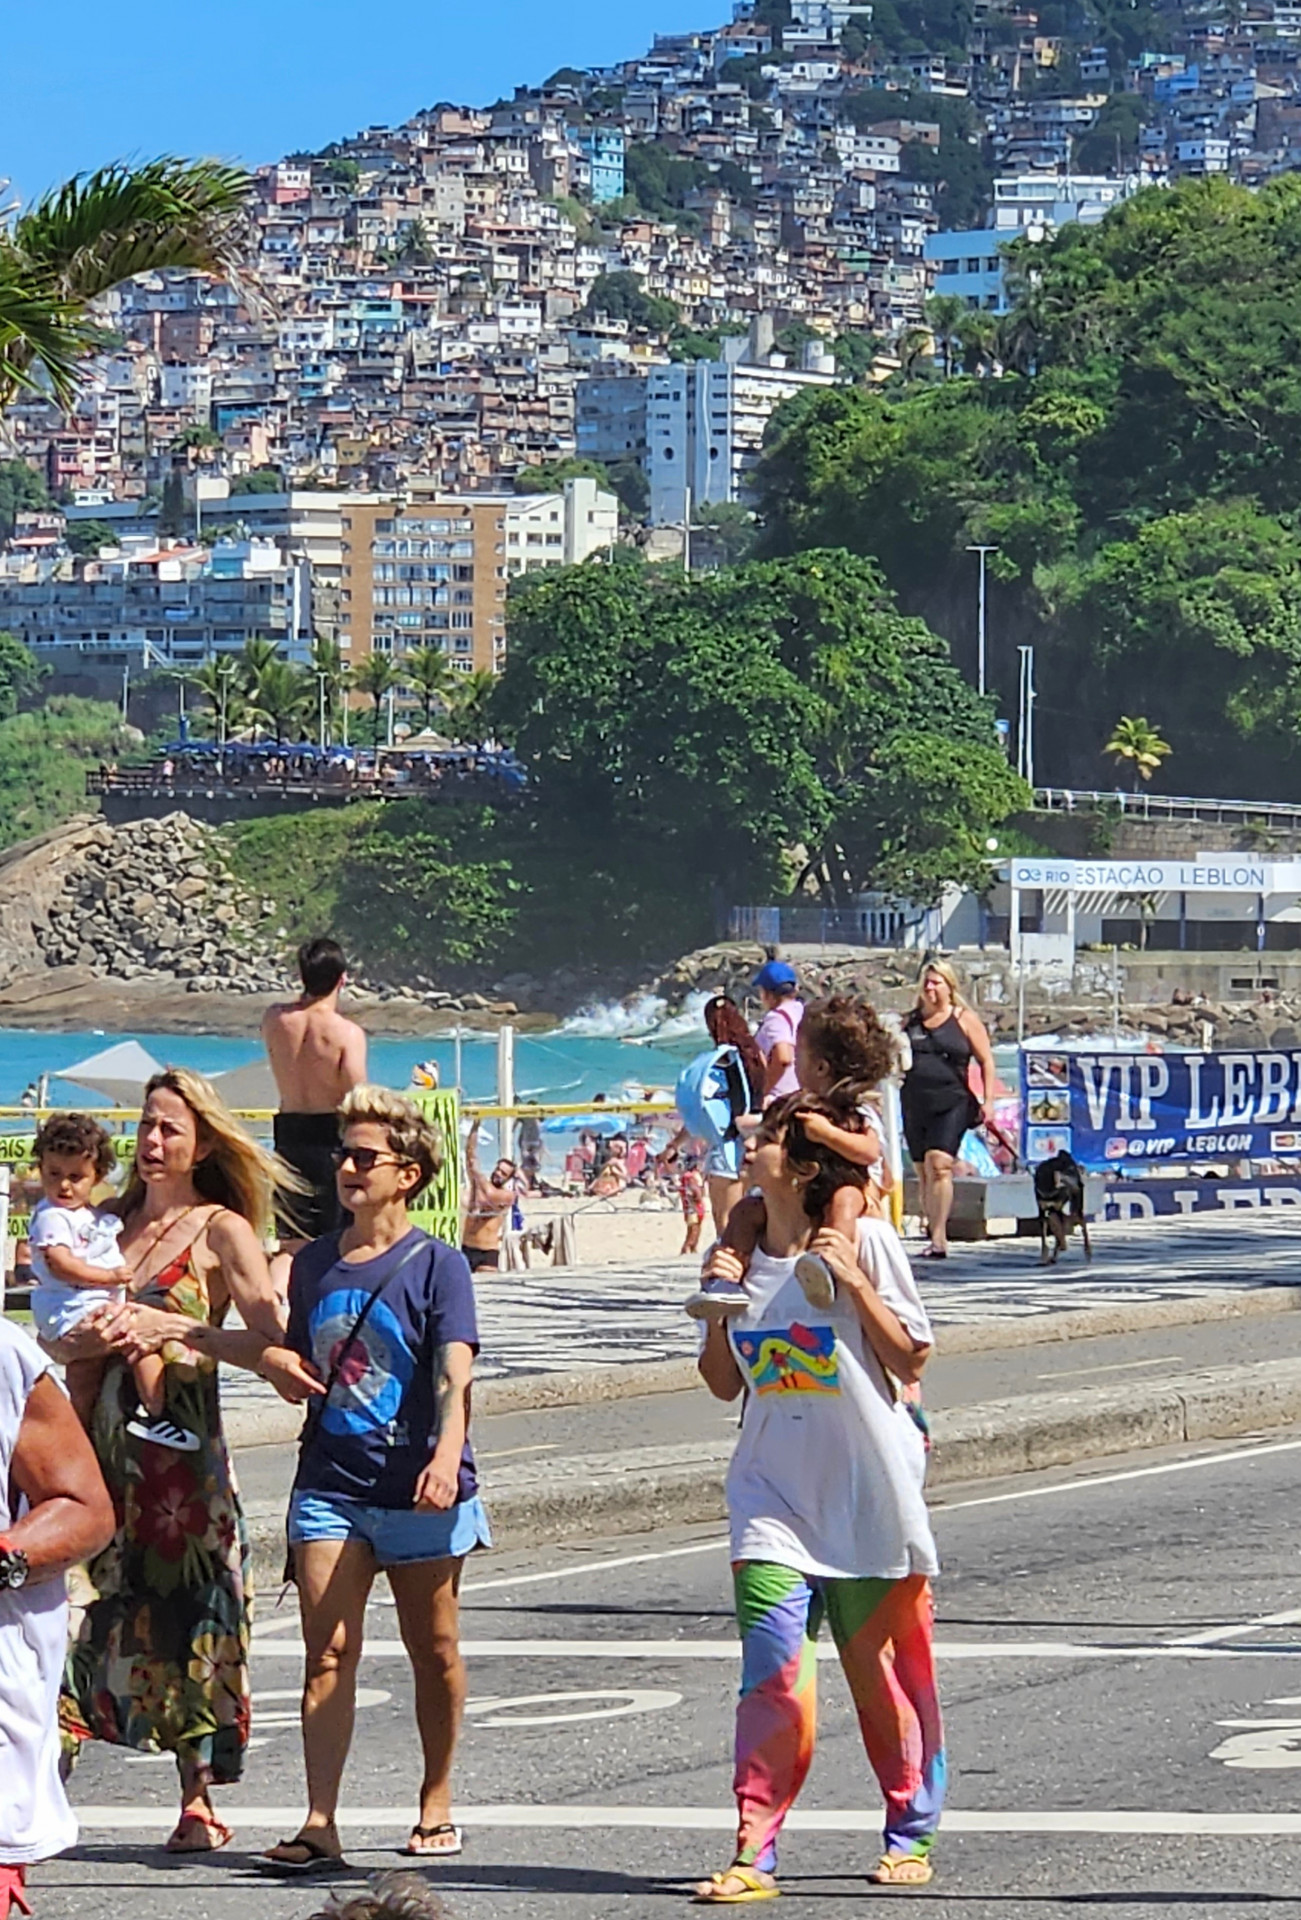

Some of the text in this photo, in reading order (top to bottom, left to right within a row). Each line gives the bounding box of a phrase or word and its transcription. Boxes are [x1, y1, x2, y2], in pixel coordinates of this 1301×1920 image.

[1045, 871, 1070, 883] RIO
[1180, 867, 1265, 886] LEBLON
[1076, 1056, 1170, 1130] VIP
